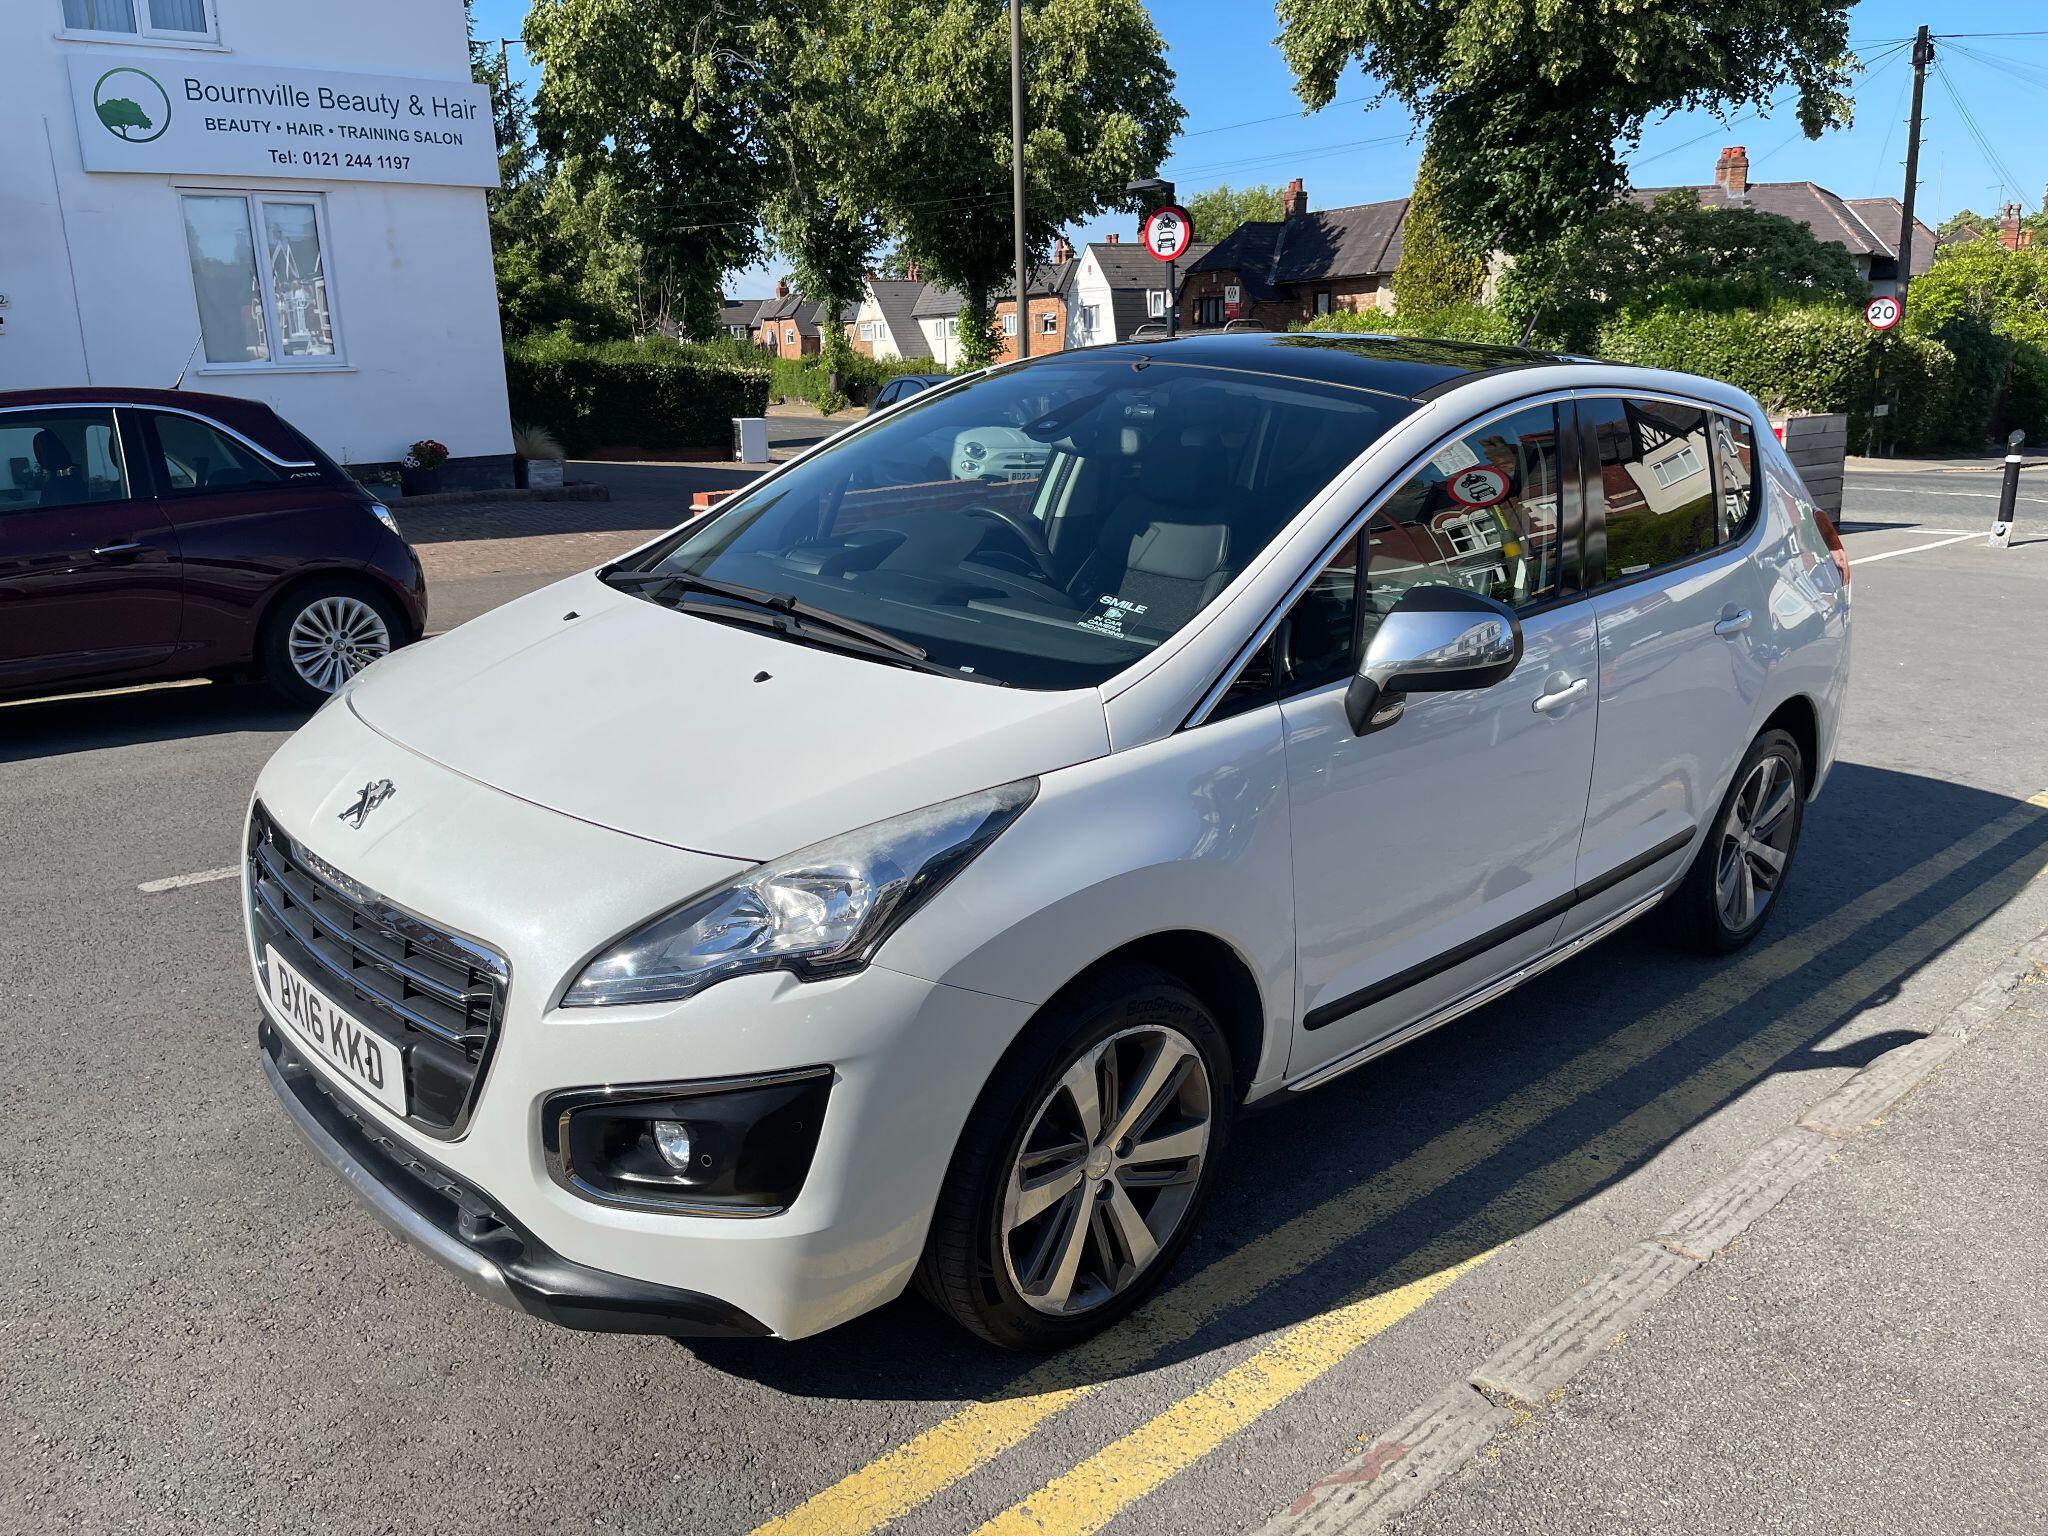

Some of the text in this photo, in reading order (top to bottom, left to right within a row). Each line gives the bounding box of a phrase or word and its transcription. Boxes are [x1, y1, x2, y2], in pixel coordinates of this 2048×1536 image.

[184, 78, 477, 119] Bournville Beauty & Hair
[204, 117, 463, 145] BEAUTY HAIR TRAINING SALON
[268, 149, 410, 169] Tel: 0121 244 1197
[1871, 306, 1895, 319] 20
[1099, 595, 1148, 614] SMILE
[1077, 621, 1125, 638] RECORDING
[1087, 619, 1121, 632] CAMERA
[1104, 619, 1122, 627] CAR
[277, 961, 384, 1090] BX16 KKD
